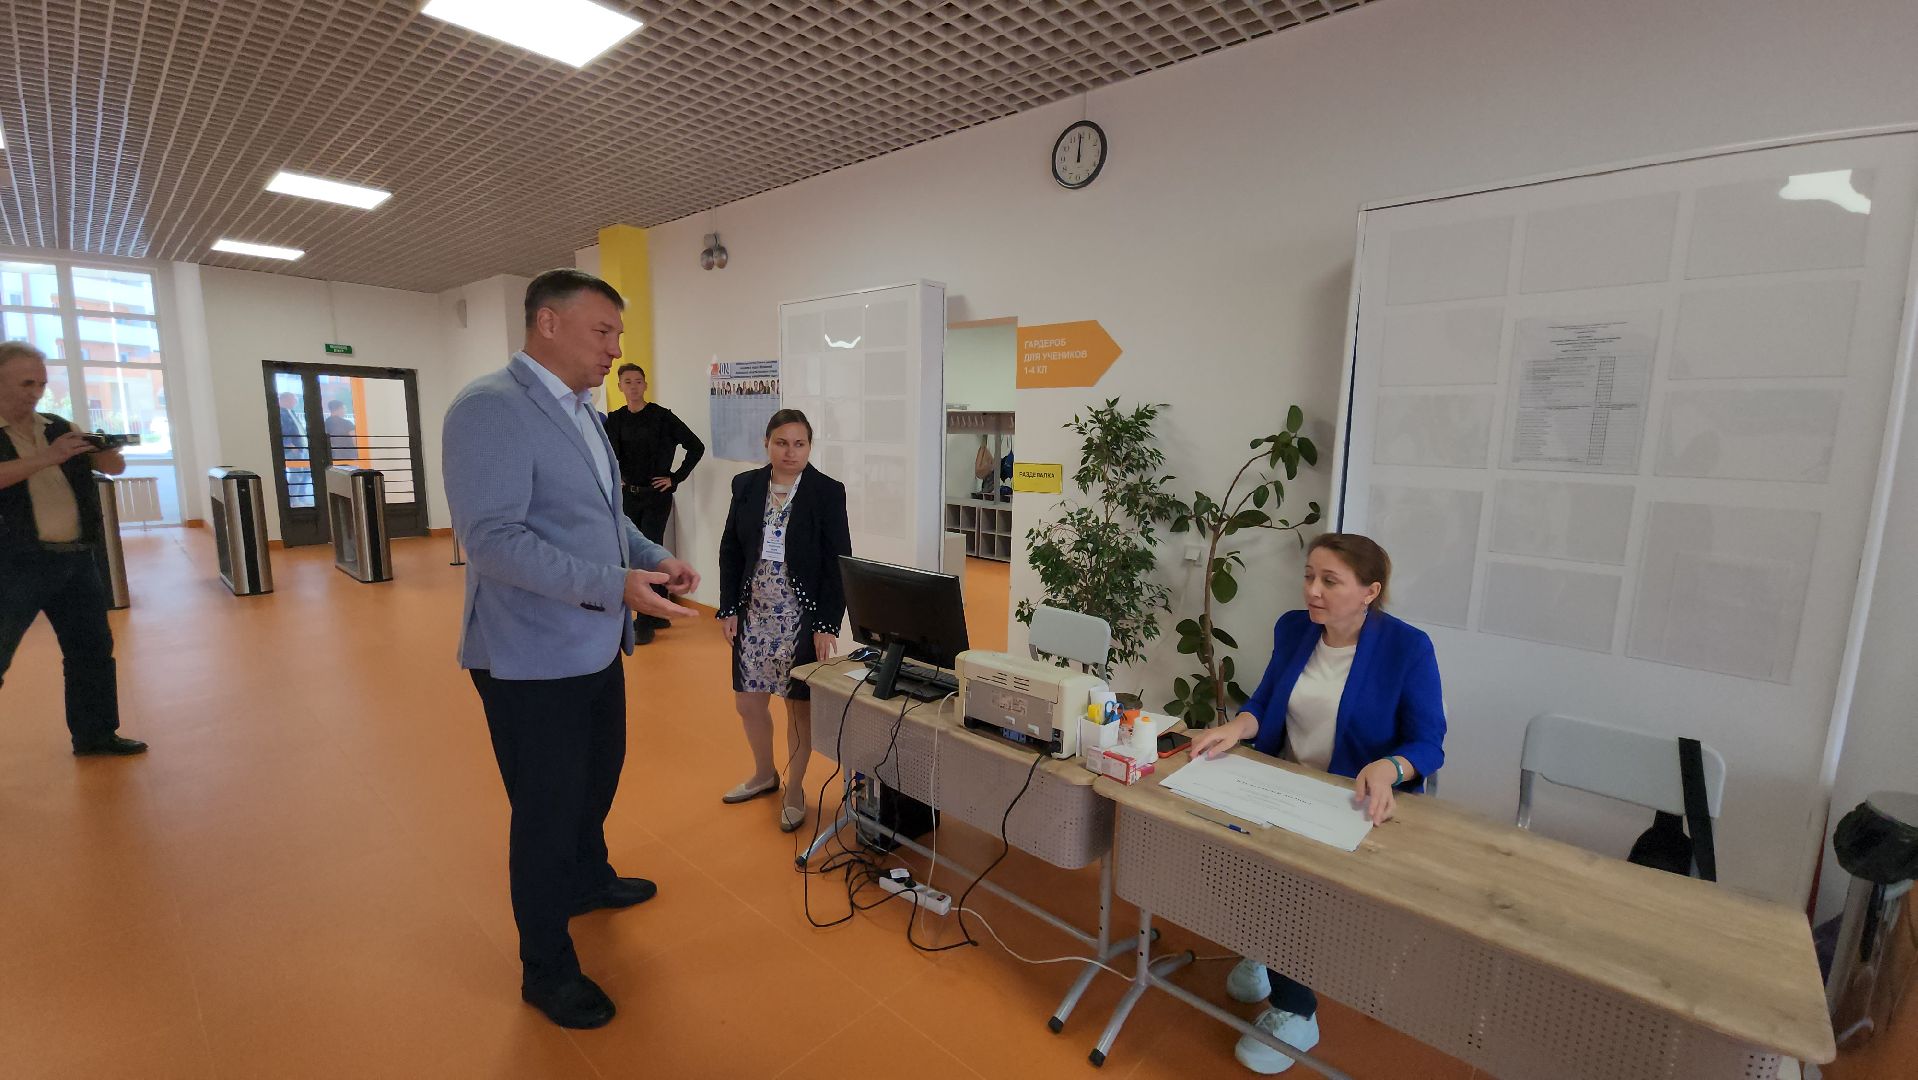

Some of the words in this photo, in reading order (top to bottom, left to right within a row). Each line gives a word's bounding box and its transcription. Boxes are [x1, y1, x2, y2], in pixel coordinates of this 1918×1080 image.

[1024, 338, 1066, 349] ГАРДЕРОБ
[1024, 352, 1040, 363] ДЛЯ
[1042, 350, 1088, 360] УЧЕНИКОВ
